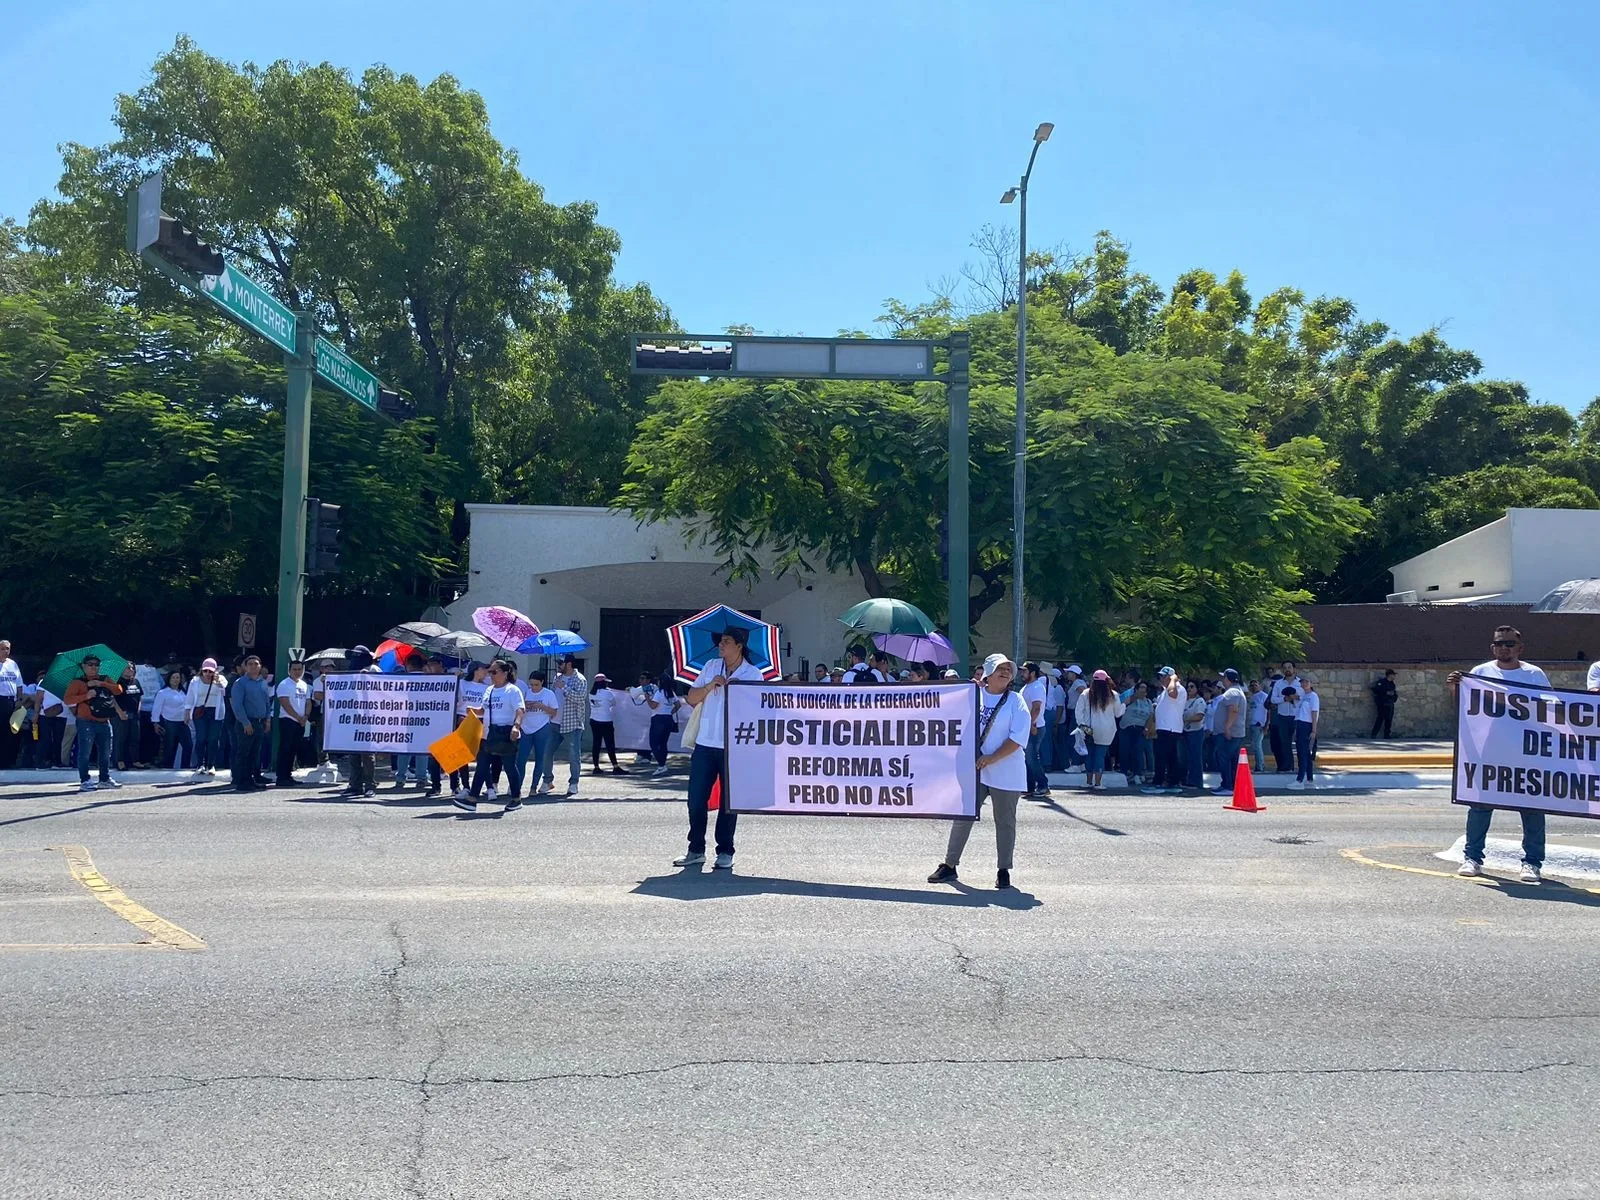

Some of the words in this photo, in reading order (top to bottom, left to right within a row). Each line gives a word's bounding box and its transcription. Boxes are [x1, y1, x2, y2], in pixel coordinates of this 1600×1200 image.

[235, 282, 293, 340] MONTERREY
[317, 349, 330, 373] LOS
[330, 359, 367, 398] NARANJOS
[326, 681, 348, 691] PODER
[348, 680, 382, 691] JUDICIAL
[383, 681, 394, 691] DE
[394, 681, 404, 692] LA
[405, 680, 456, 692] FEDERACIÓN
[335, 699, 379, 711] podemos
[379, 699, 404, 711] dejar
[405, 700, 414, 711] la
[415, 700, 450, 712] justicia
[760, 692, 795, 709] PODER
[796, 692, 842, 709] JUDICIAL
[843, 693, 857, 709] DE
[859, 693, 873, 709] LA
[874, 689, 941, 709] FEDERACIÓN
[338, 713, 352, 724] de
[352, 713, 386, 726] México
[387, 716, 399, 726] en
[400, 717, 430, 727] manos
[354, 729, 414, 744] inexpertas!
[734, 719, 962, 746] #JUSTICIALIBRE
[1522, 729, 1553, 757] DE
[1558, 732, 1600, 762] INT
[787, 756, 883, 777] REFORMA
[888, 754, 914, 779] SÍ,
[1463, 762, 1477, 789] Y
[1481, 764, 1600, 802] PRESIONE
[788, 784, 839, 804] PERO
[844, 785, 873, 805] NO
[877, 783, 914, 806] ASÍ
